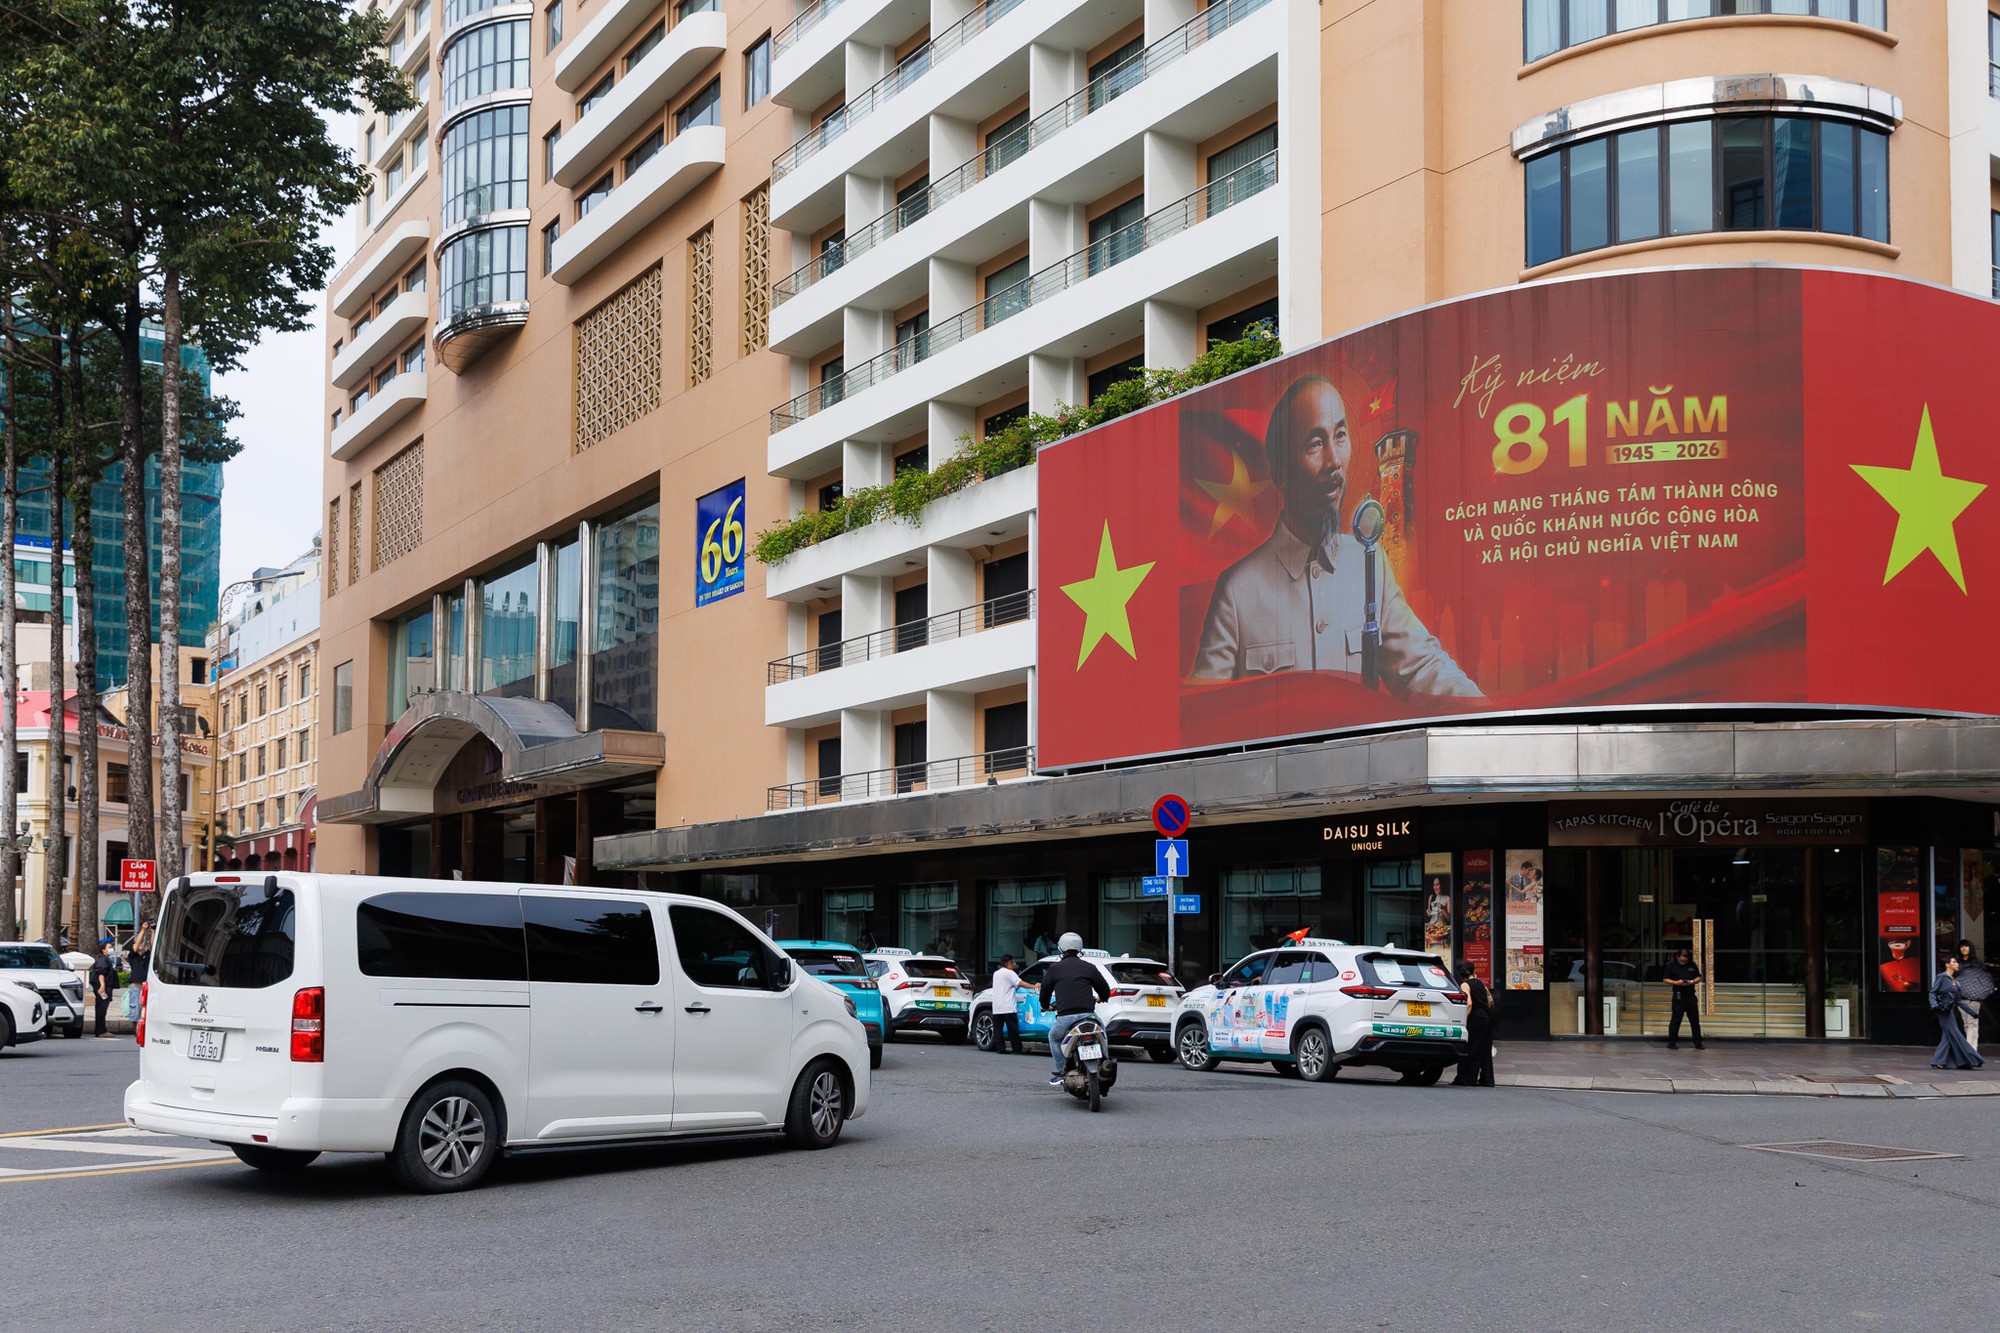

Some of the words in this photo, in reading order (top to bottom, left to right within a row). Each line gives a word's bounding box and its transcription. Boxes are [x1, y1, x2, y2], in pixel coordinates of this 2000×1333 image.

[1453, 354, 1505, 418] Kỷ
[1516, 353, 1606, 386] niệm
[1606, 385, 1728, 438] NĂM
[1492, 394, 1588, 475] 81
[1613, 445, 1654, 462] 1945
[1676, 442, 1720, 458] 2026
[1445, 496, 1487, 521] CÁCH
[1493, 496, 1543, 517] MẠNG
[1549, 487, 1610, 508] THÁNG
[1617, 483, 1656, 502] TÁM
[1663, 479, 1724, 499] THÀNH
[1730, 478, 1778, 497] CÔNG
[1464, 520, 1484, 542] VÀ
[1490, 514, 1536, 540] QUỐC
[1543, 509, 1603, 533] KHÁNH
[1610, 505, 1660, 527] NƯỚC
[1667, 505, 1717, 528] CỘNG
[1723, 505, 1759, 523] HÒA
[701, 495, 743, 583] 66
[1481, 545, 1503, 564] XÃ
[1510, 541, 1538, 563] HỘI
[1545, 536, 1581, 557] CHỦ
[1587, 533, 1643, 554] NGHĨA
[1650, 531, 1691, 552] VIỆT
[1697, 533, 1739, 549] NAM
[1669, 800, 1700, 819] Café
[1704, 801, 1719, 813] de
[1765, 813, 1862, 825] SaigonSaigon
[1323, 824, 1369, 840] DAISU
[1376, 821, 1410, 837] SILK
[1555, 814, 1595, 831] TAPAS
[1599, 814, 1653, 831] KITCHEN
[1776, 828, 1823, 836] ROOFTOP
[1830, 828, 1850, 836] BAR
[1351, 841, 1383, 851] UNIQUE
[199, 1032, 213, 1045] 51L
[192, 1045, 218, 1059] 130.90
